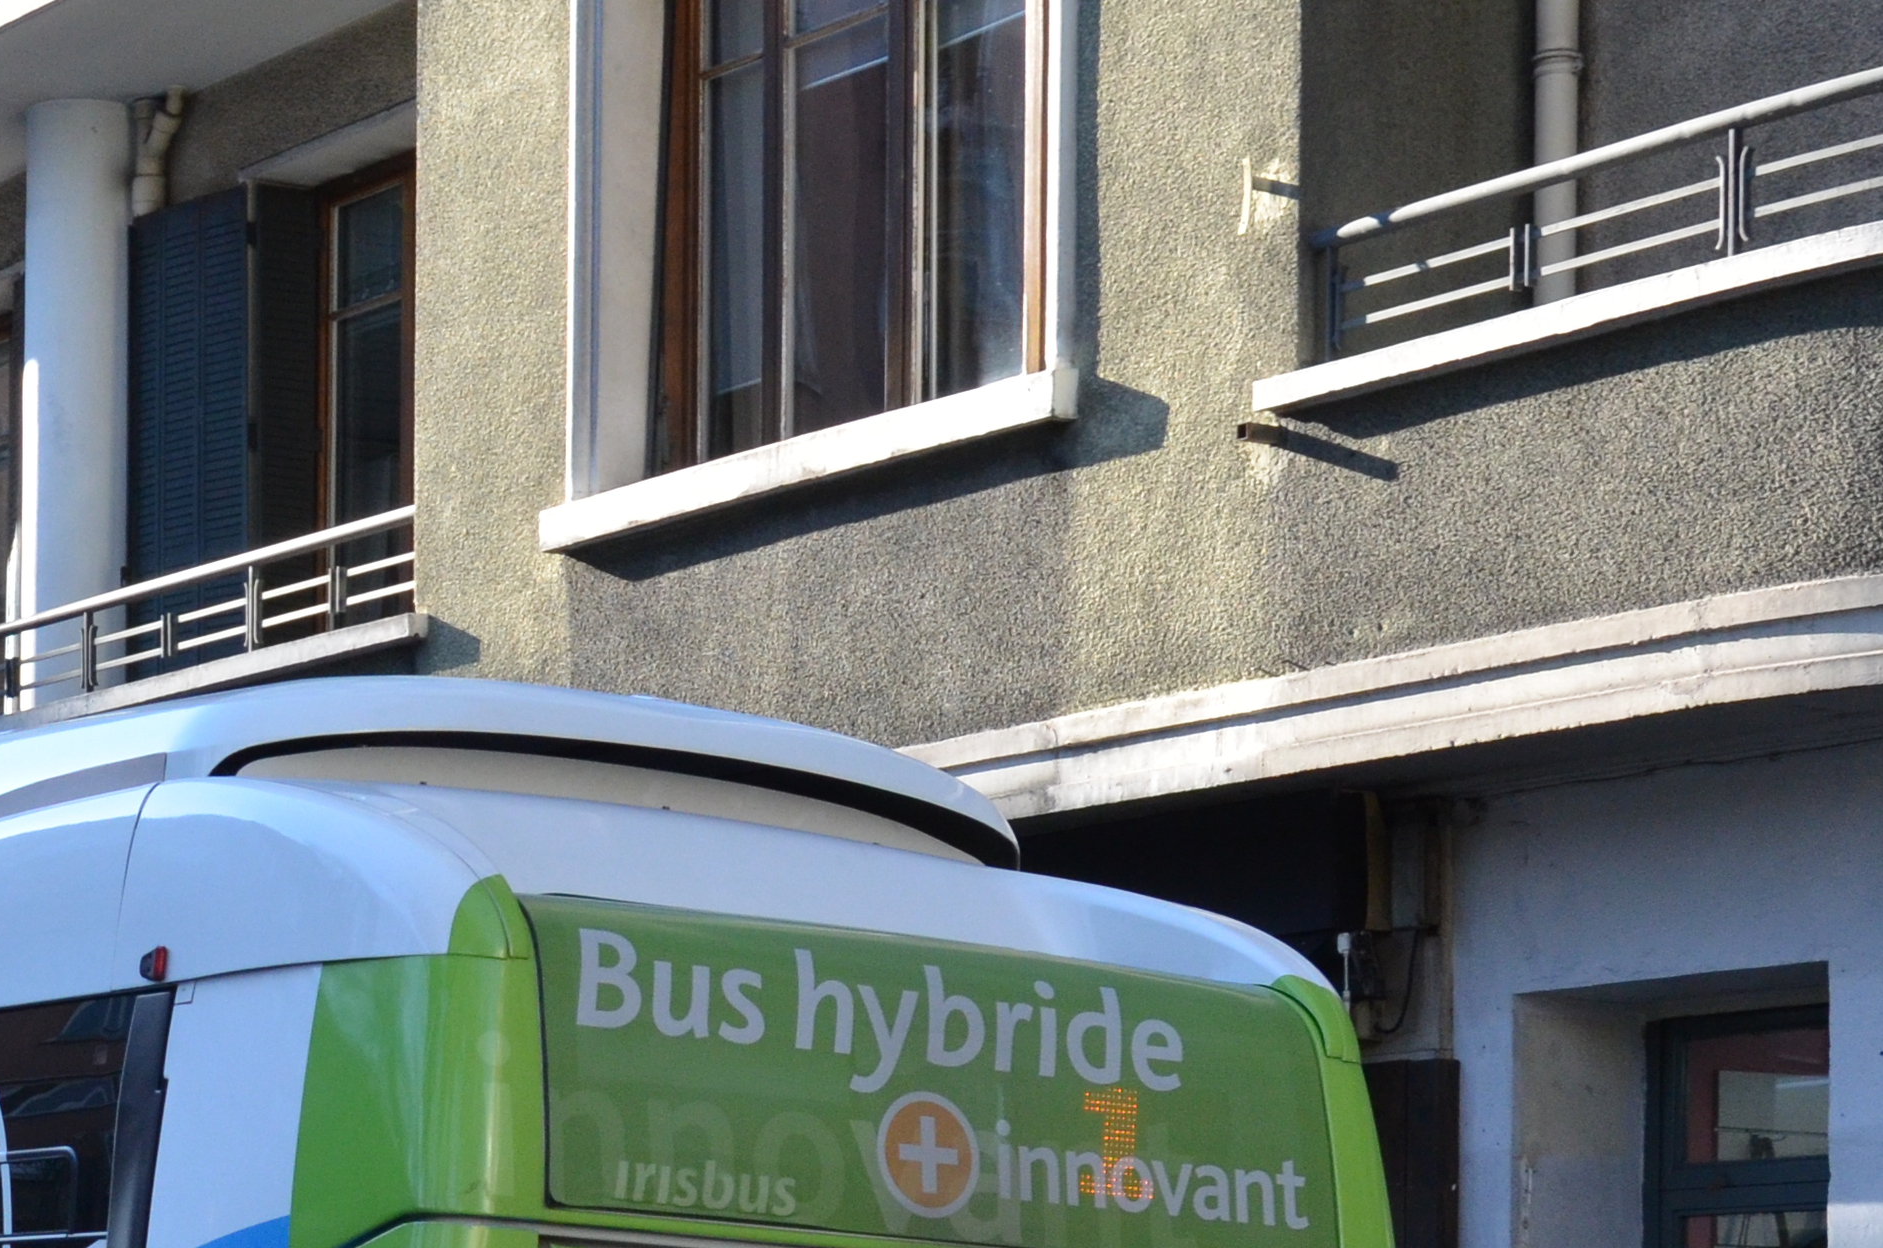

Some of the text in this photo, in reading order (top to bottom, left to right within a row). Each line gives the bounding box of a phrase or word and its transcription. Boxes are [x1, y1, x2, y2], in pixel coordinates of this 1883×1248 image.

[575, 926, 1185, 1094] Bus hybride
[999, 1119, 1310, 1231] innovant
[1079, 1086, 1155, 1202] 1
